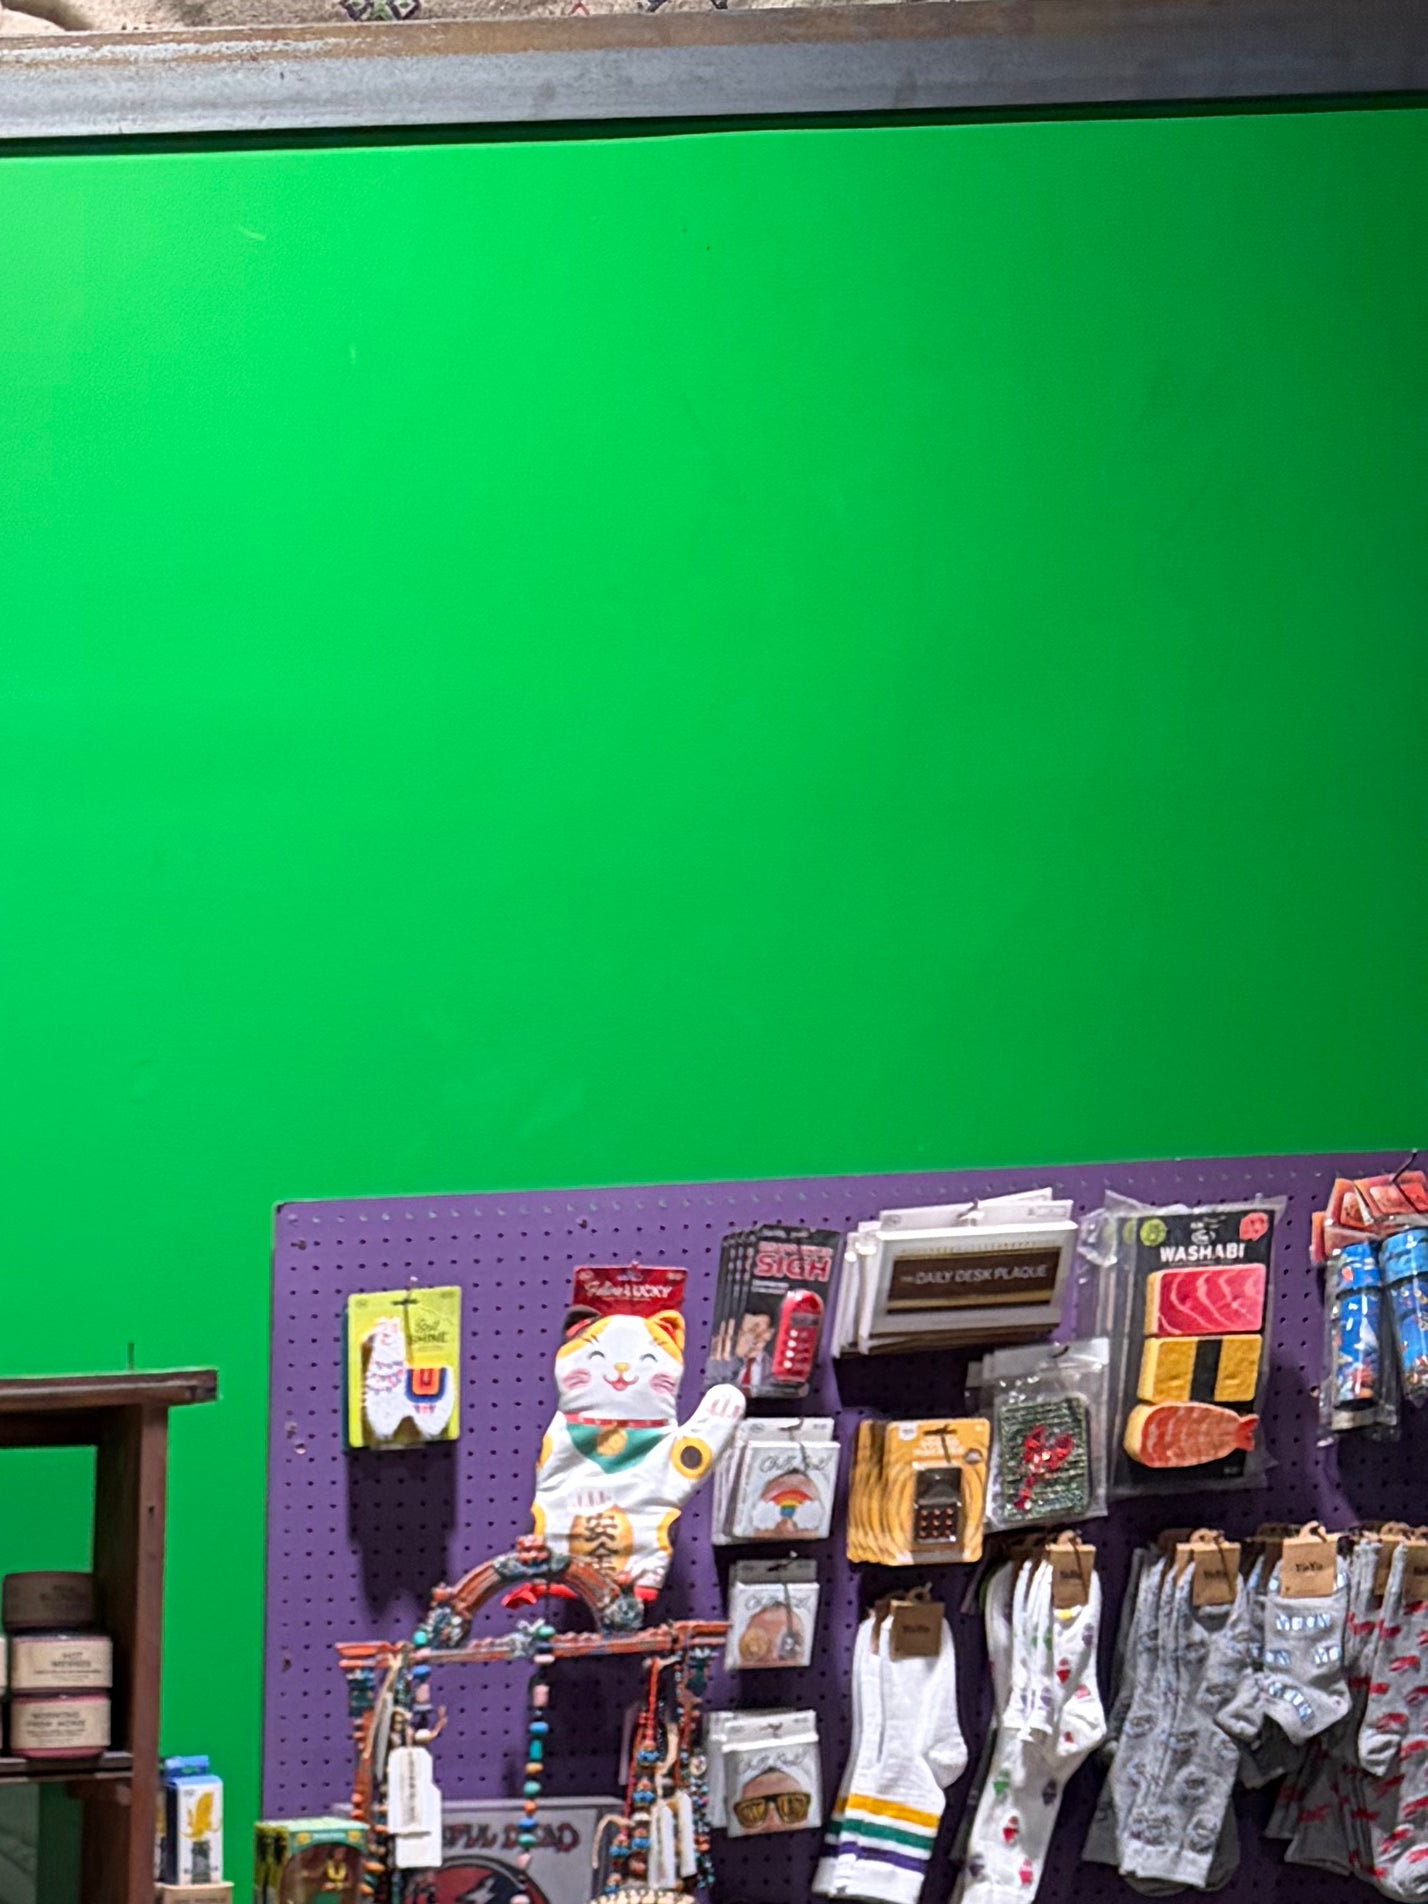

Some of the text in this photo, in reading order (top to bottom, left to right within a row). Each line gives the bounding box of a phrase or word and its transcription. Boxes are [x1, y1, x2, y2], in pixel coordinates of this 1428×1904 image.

[1160, 1242, 1246, 1262] WASHABI
[754, 1253, 832, 1282] SIGH
[955, 1268, 993, 1282] DESK
[501, 1822, 580, 1852] DAD
